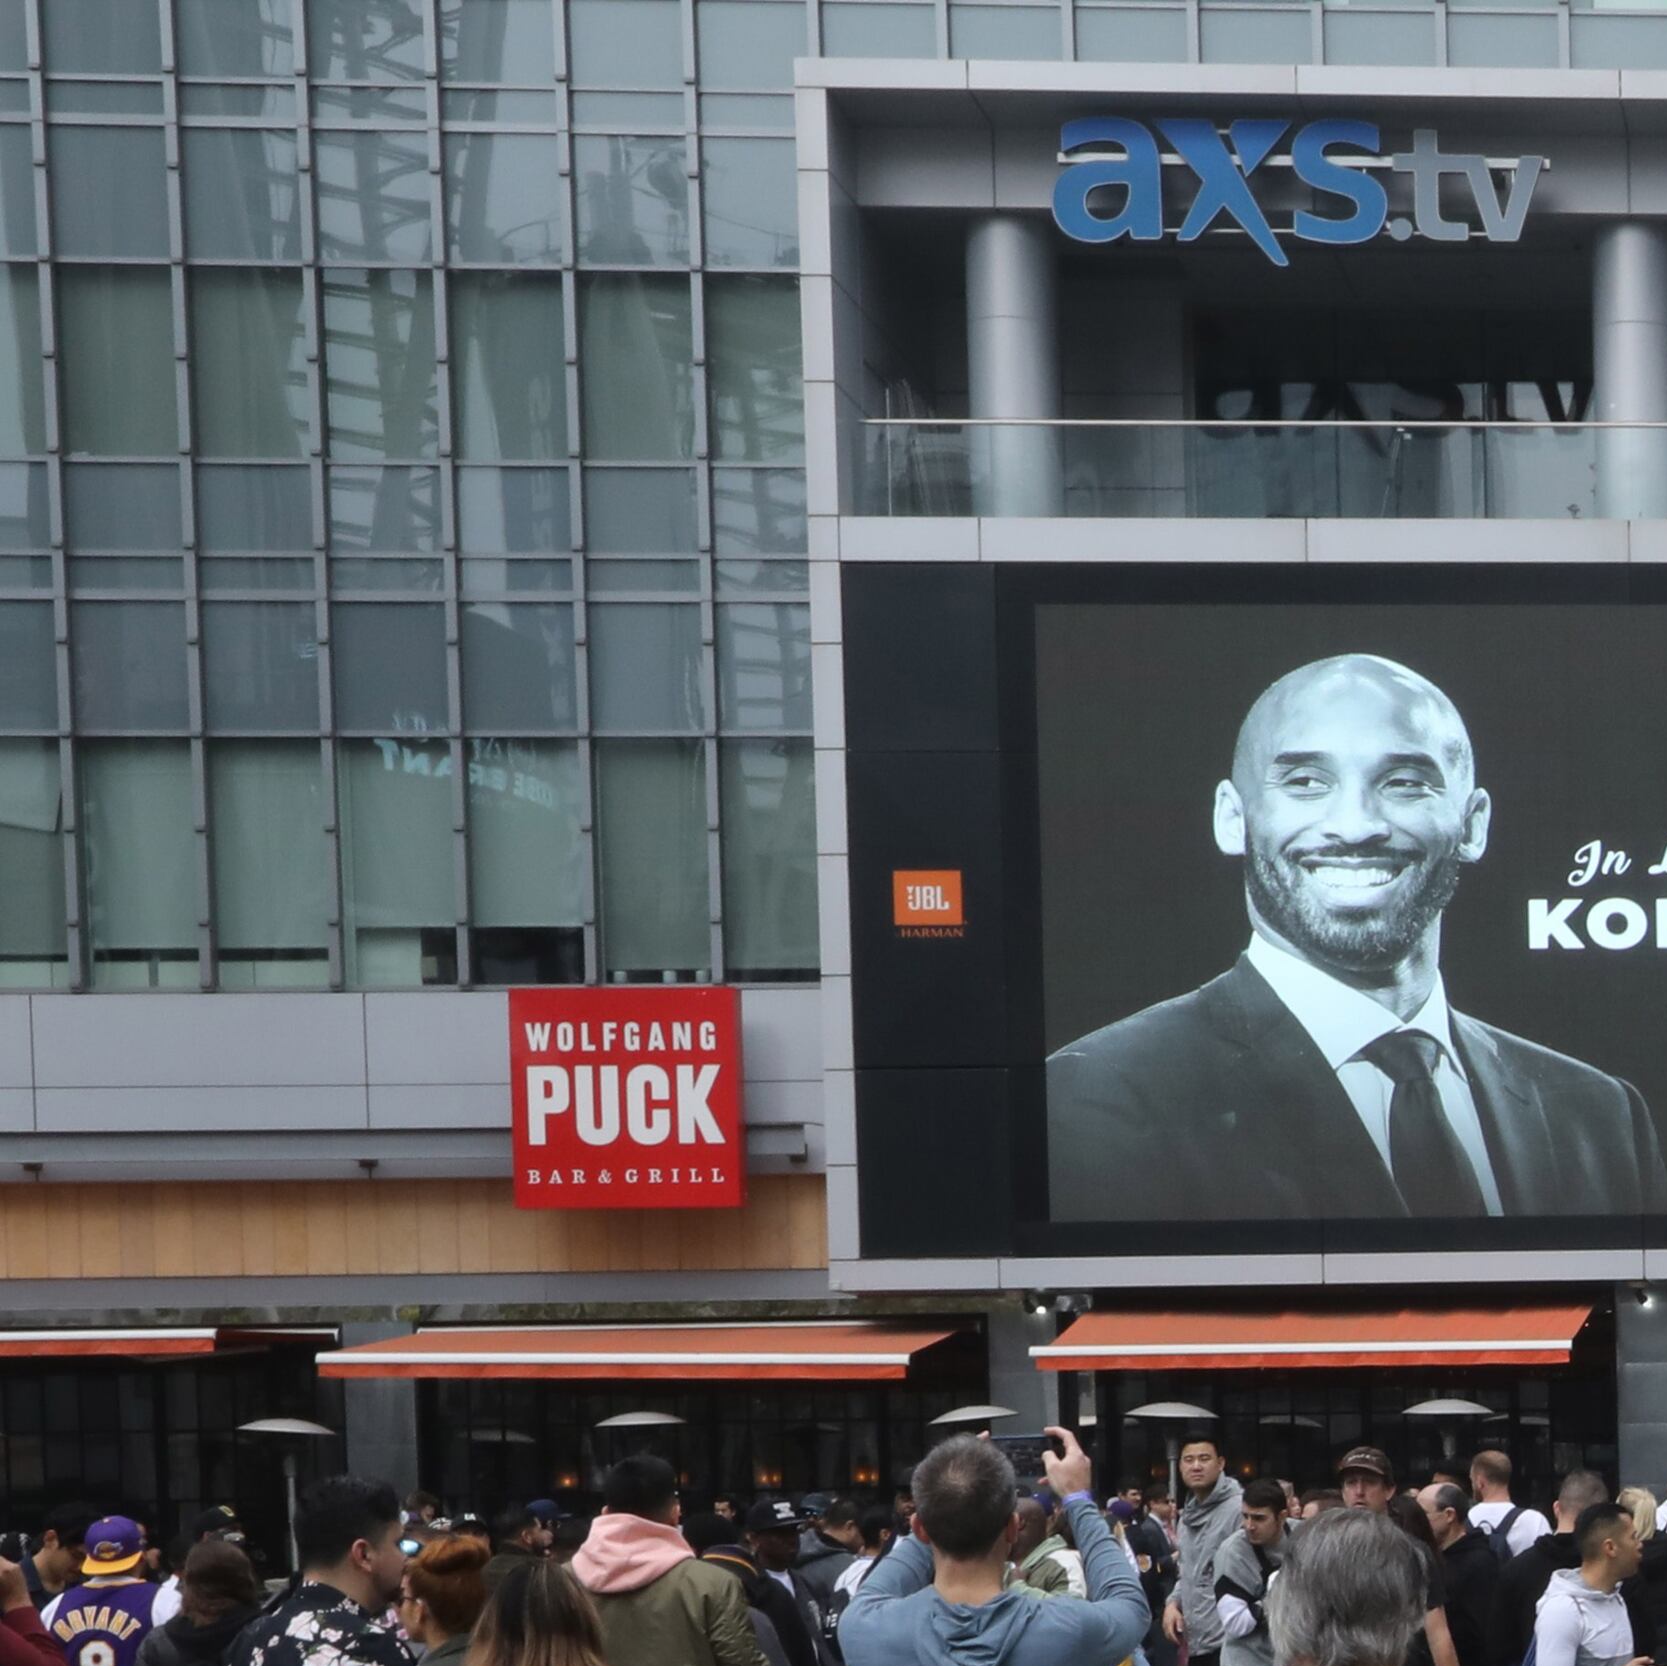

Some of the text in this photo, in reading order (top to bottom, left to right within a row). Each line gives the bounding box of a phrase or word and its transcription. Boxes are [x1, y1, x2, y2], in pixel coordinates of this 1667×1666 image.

[1052, 115, 1543, 267] axs.tv
[1567, 839, 1632, 887] In
[906, 885, 950, 910] JBL
[901, 927, 963, 938] HARMAN
[525, 1021, 717, 1052] WOLFGANG
[526, 1063, 726, 1146] PUCK
[528, 1168, 725, 1184] BAR & GRILL
[53, 1605, 142, 1643] BRYANT
